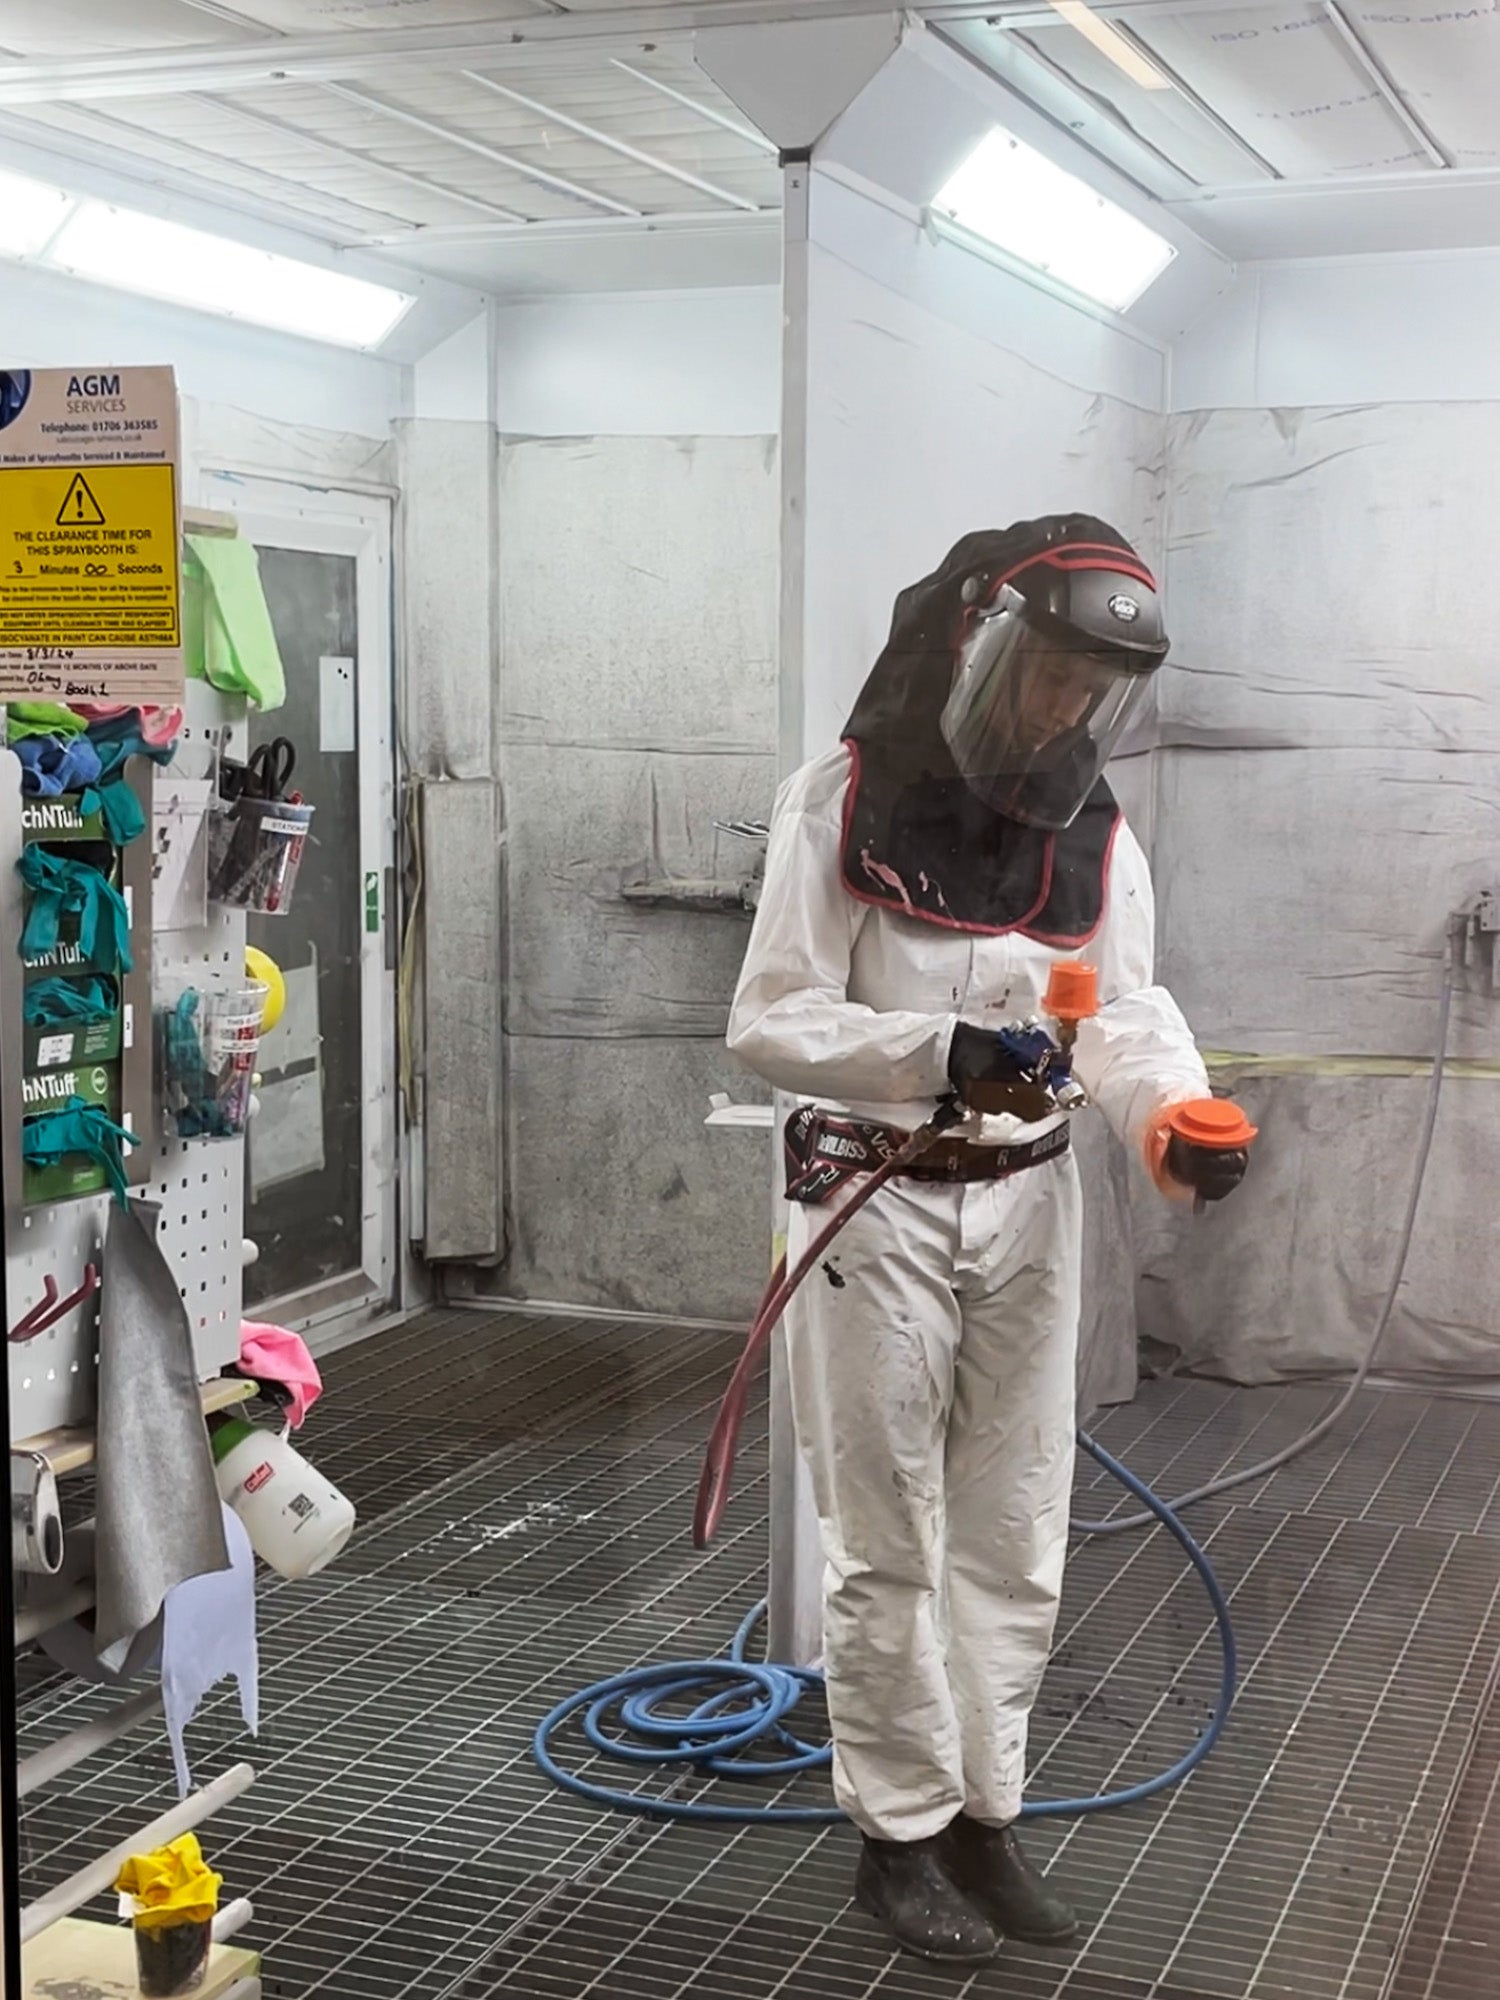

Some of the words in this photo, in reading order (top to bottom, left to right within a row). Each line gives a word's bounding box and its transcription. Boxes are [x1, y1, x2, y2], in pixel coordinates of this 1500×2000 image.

[66, 375, 120, 397] AGM
[66, 399, 126, 414] SERVICES
[41, 422, 89, 434] Telephone:
[92, 421, 121, 432] 01706
[123, 419, 158, 431] 363585
[14, 531, 33, 542] THE
[36, 530, 99, 542] CLEARANCE
[102, 530, 127, 541] TIME
[129, 529, 152, 540] FOR
[26, 545, 50, 556] THIS
[52, 545, 123, 556] SPRAYBOOTH
[13, 560, 23, 574] 3
[39, 564, 80, 575] Minutes
[117, 563, 163, 575] Seconds
[62, 633, 86, 642] PAINT
[88, 633, 107, 642] CAN
[108, 633, 136, 642] CAUSE
[138, 633, 174, 642] ASTHMA
